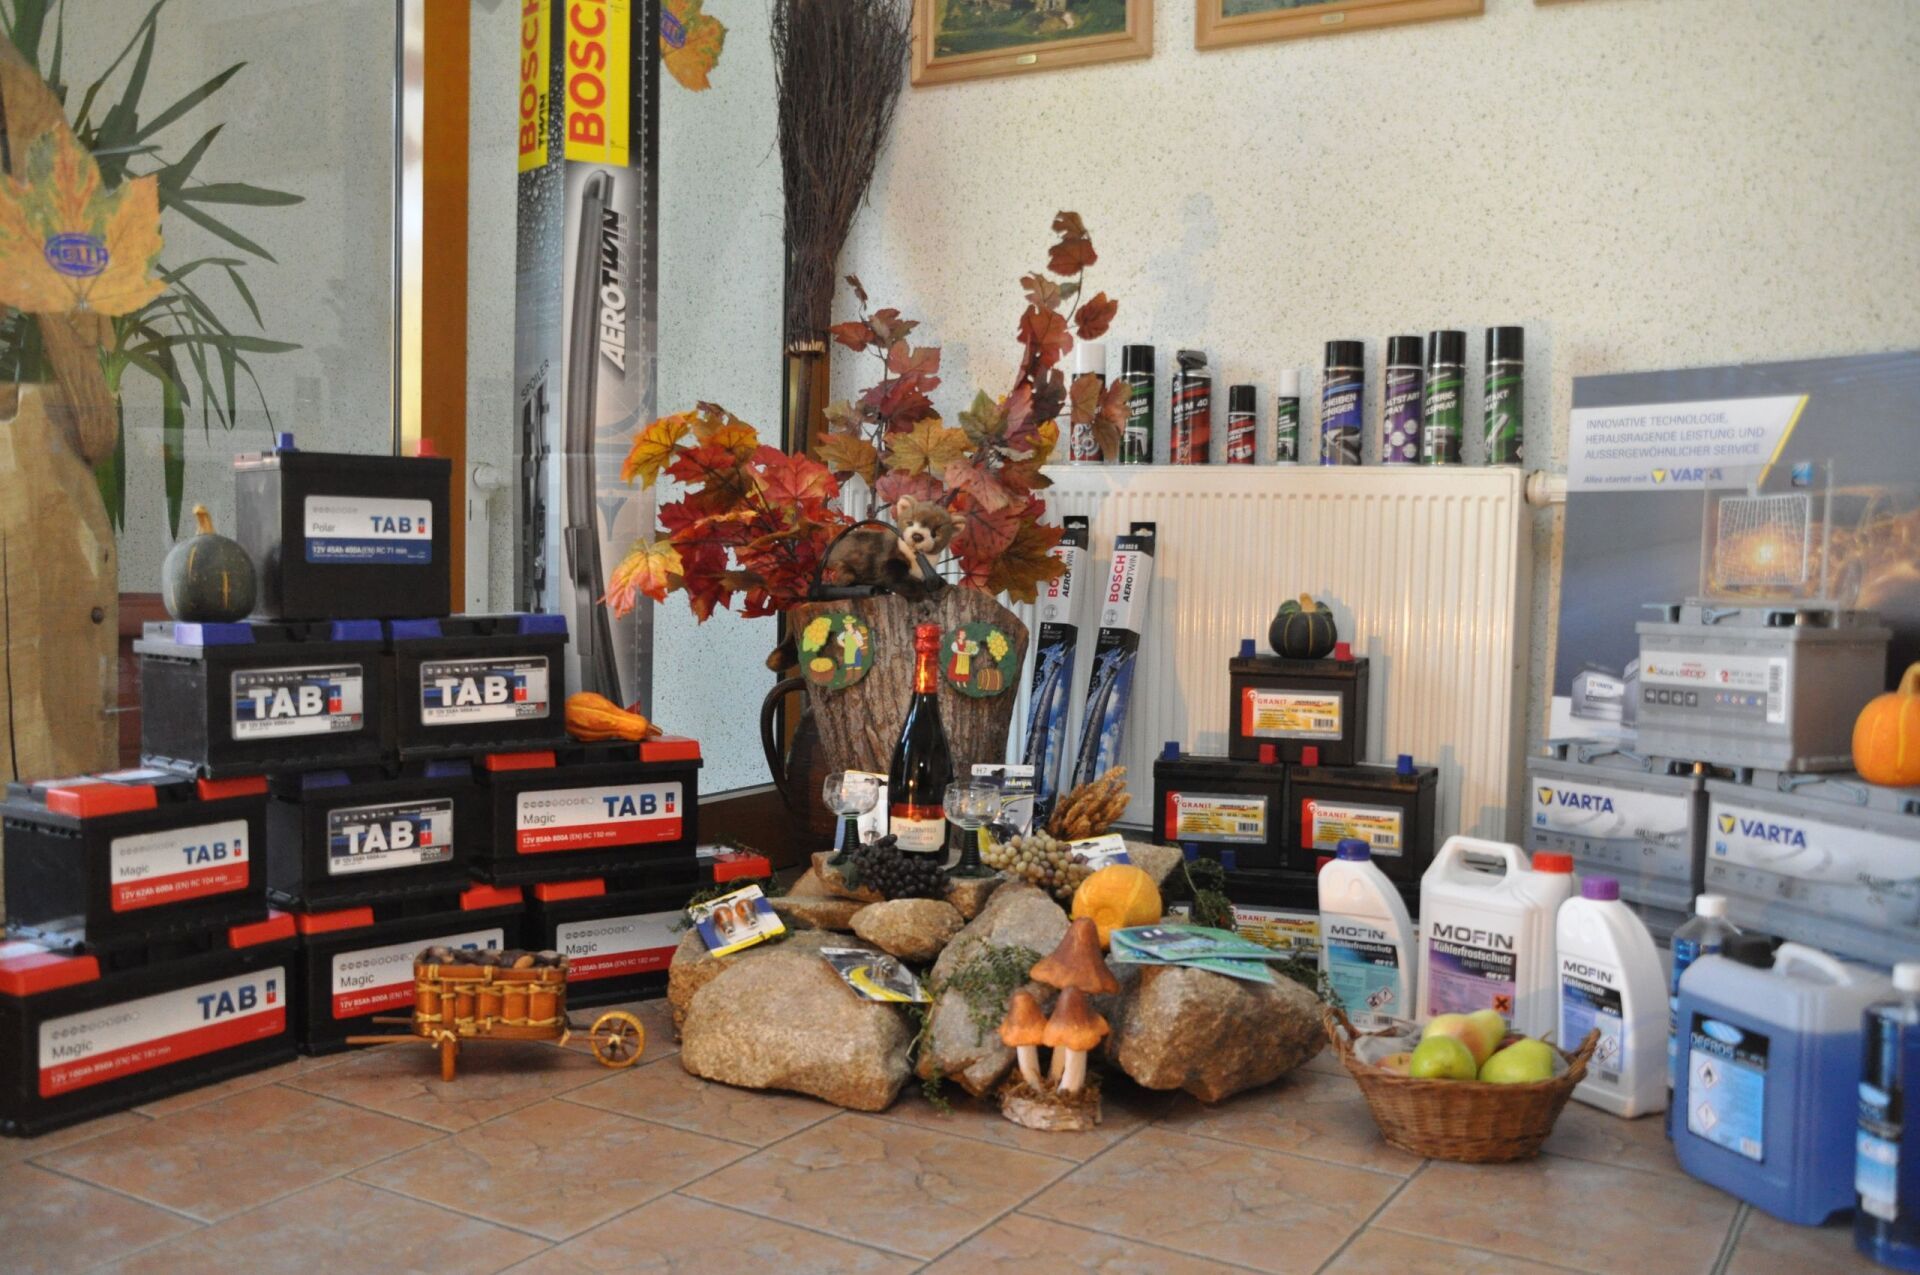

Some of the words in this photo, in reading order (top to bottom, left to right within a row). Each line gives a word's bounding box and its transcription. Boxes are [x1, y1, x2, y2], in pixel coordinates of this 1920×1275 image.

[569, 0, 607, 147] BOSC
[520, 358, 550, 401] SPOILER
[1197, 398, 1208, 408] 40
[1322, 392, 1357, 409] CHEIBEN
[1384, 403, 1405, 417] PRAY
[1586, 416, 1646, 430] INNOVATIVE
[1585, 431, 1678, 445] HERAUSRAGENDE
[1680, 428, 1735, 442] LEISTUNG
[1738, 427, 1765, 438] UND
[1585, 446, 1710, 460] AUSSERGEWÖHNLICHER
[1713, 443, 1761, 456] SERVICE
[1670, 467, 1723, 482] VARTA
[312, 522, 336, 533] Polar
[370, 516, 412, 534] TAB
[312, 545, 326, 555] 12V
[1048, 550, 1063, 598] BOH
[1108, 554, 1127, 603] BOSCH
[435, 675, 509, 707] TAB
[248, 685, 324, 720] TAB
[976, 767, 988, 775] H7
[523, 812, 556, 826] Magic
[603, 793, 658, 819] TAB
[1181, 801, 1212, 809] GRANIT
[1557, 790, 1615, 814] VARTA
[1316, 810, 1347, 818] GRANIT
[342, 820, 415, 855] TAB
[522, 836, 535, 845] 12V
[1740, 818, 1807, 849] VARTA
[120, 864, 150, 878] Magic
[182, 841, 227, 866] TAB
[121, 890, 136, 900] 12V
[1237, 914, 1267, 922] GRANIT
[1330, 925, 1385, 940] MOFIN
[1433, 921, 1514, 950] MOFIN
[565, 942, 598, 956] Magic
[1433, 941, 1512, 966] Kühlerfrostschutz
[1563, 959, 1612, 984] MOFIN
[340, 972, 375, 989] Magic
[340, 1000, 353, 1009] 12V
[51, 1040, 94, 1060] Magic
[197, 983, 258, 1021] TAB
[51, 1073, 68, 1085] 12V
